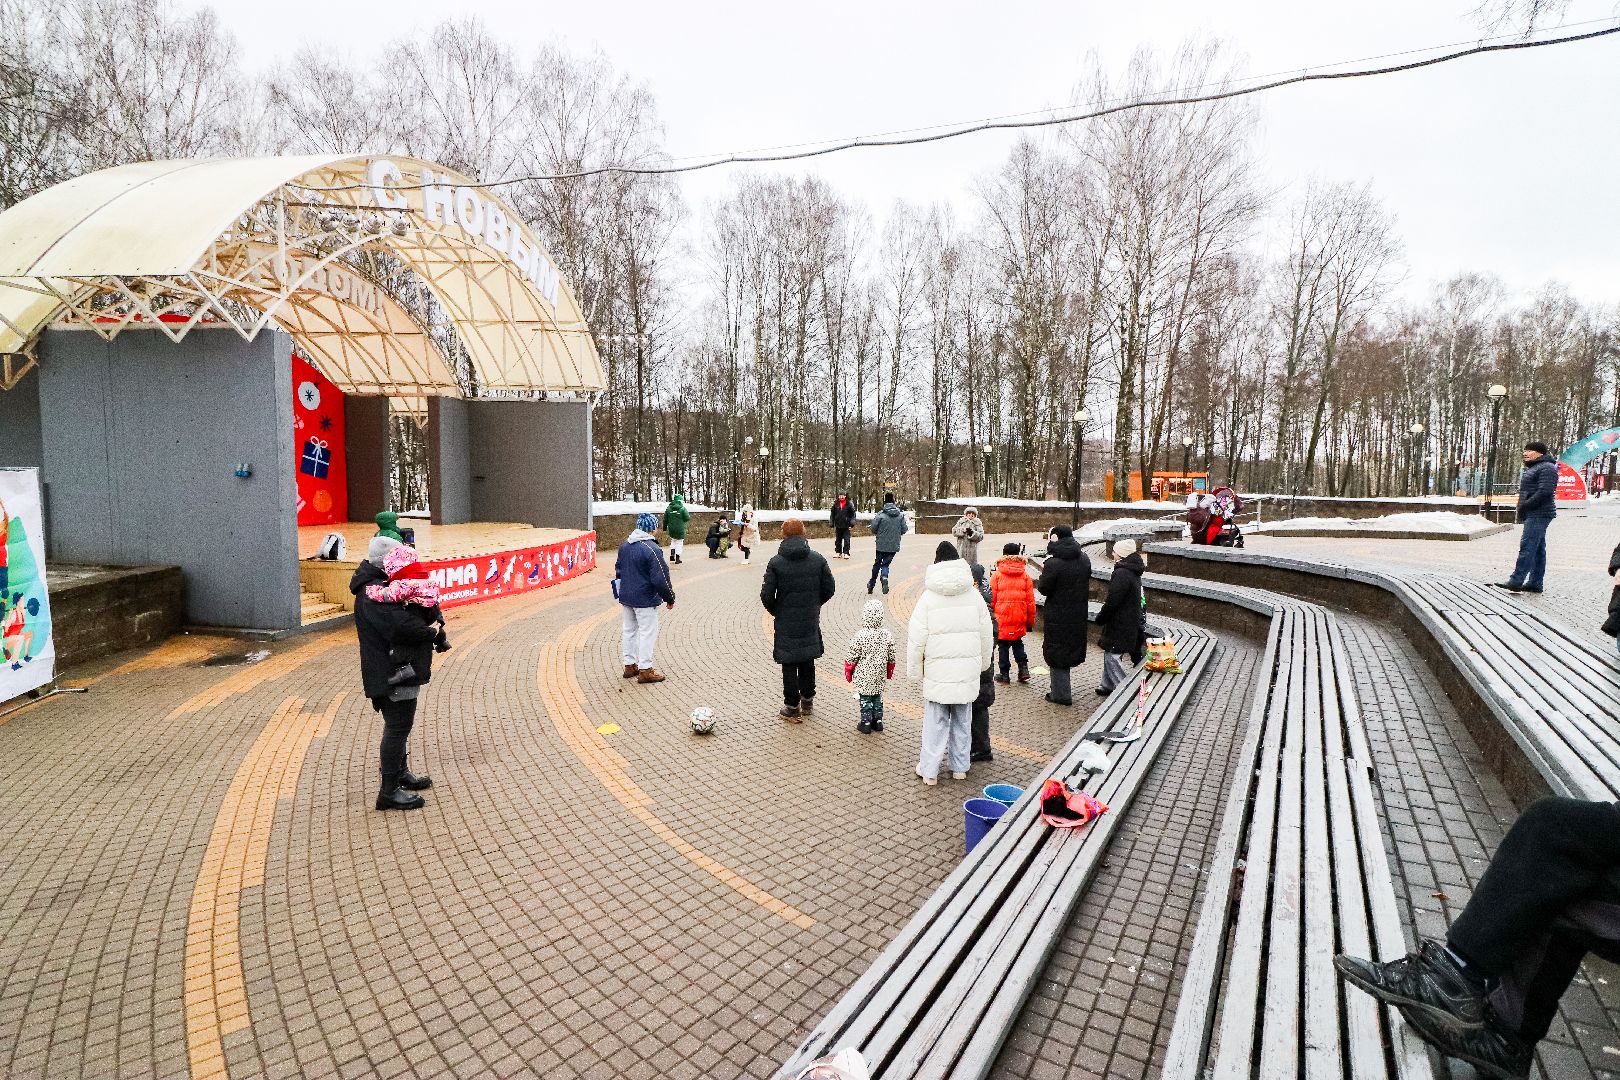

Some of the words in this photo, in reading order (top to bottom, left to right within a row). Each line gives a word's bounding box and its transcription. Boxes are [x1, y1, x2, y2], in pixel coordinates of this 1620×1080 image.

[367, 159, 408, 215] С
[420, 168, 561, 307] НОВЫМ
[429, 563, 478, 589] ИМА
[438, 587, 479, 603] МОСКОВЬЕ
